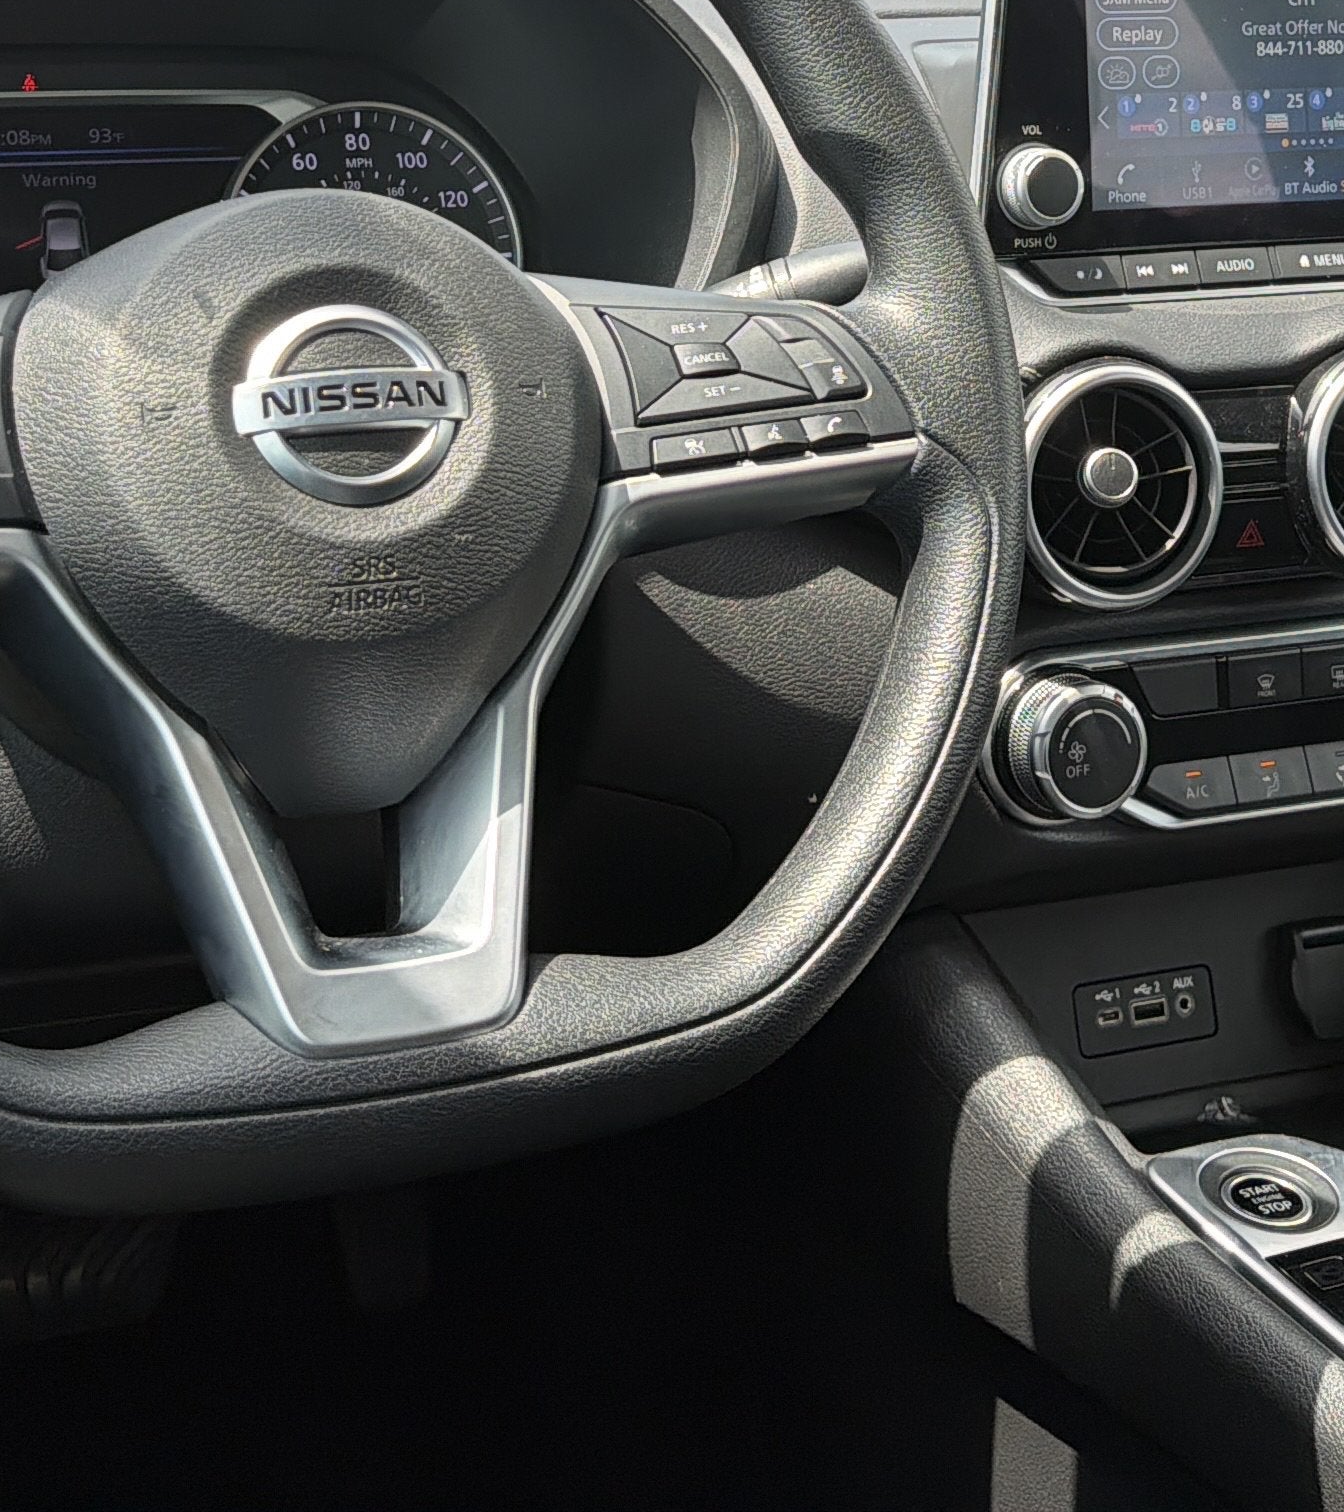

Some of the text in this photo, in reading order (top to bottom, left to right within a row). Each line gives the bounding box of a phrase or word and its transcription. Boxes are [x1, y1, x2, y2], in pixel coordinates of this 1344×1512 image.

[1112, 25, 1163, 44] Replay
[1241, 21, 1283, 37] Great
[1285, 20, 1323, 36] Offer
[1168, 97, 1177, 113] 2
[1232, 95, 1242, 111] 8
[1286, 93, 1304, 109] 25
[1021, 124, 1043, 136] VOL
[344, 133, 370, 151] 80
[292, 153, 318, 171] 60
[345, 157, 373, 169] MPH
[396, 151, 428, 170] 100
[22, 172, 97, 189] Warning
[1284, 180, 1338, 195] BT Audio
[386, 186, 405, 198] 160
[438, 189, 469, 209] 120
[1108, 190, 1147, 203] Phone
[1182, 187, 1213, 200] USB1
[1014, 237, 1042, 249] PUSH
[1216, 258, 1255, 273] AUDIO
[671, 322, 695, 335] RES
[683, 351, 729, 365] CANCEL
[260, 379, 448, 419] NISSAN
[704, 386, 725, 399] SET
[1065, 763, 1091, 779] OFF
[1186, 785, 1209, 800] A/C
[1172, 975, 1194, 990] AUX
[1239, 1183, 1279, 1198] START
[1258, 1200, 1293, 1215] STOP
